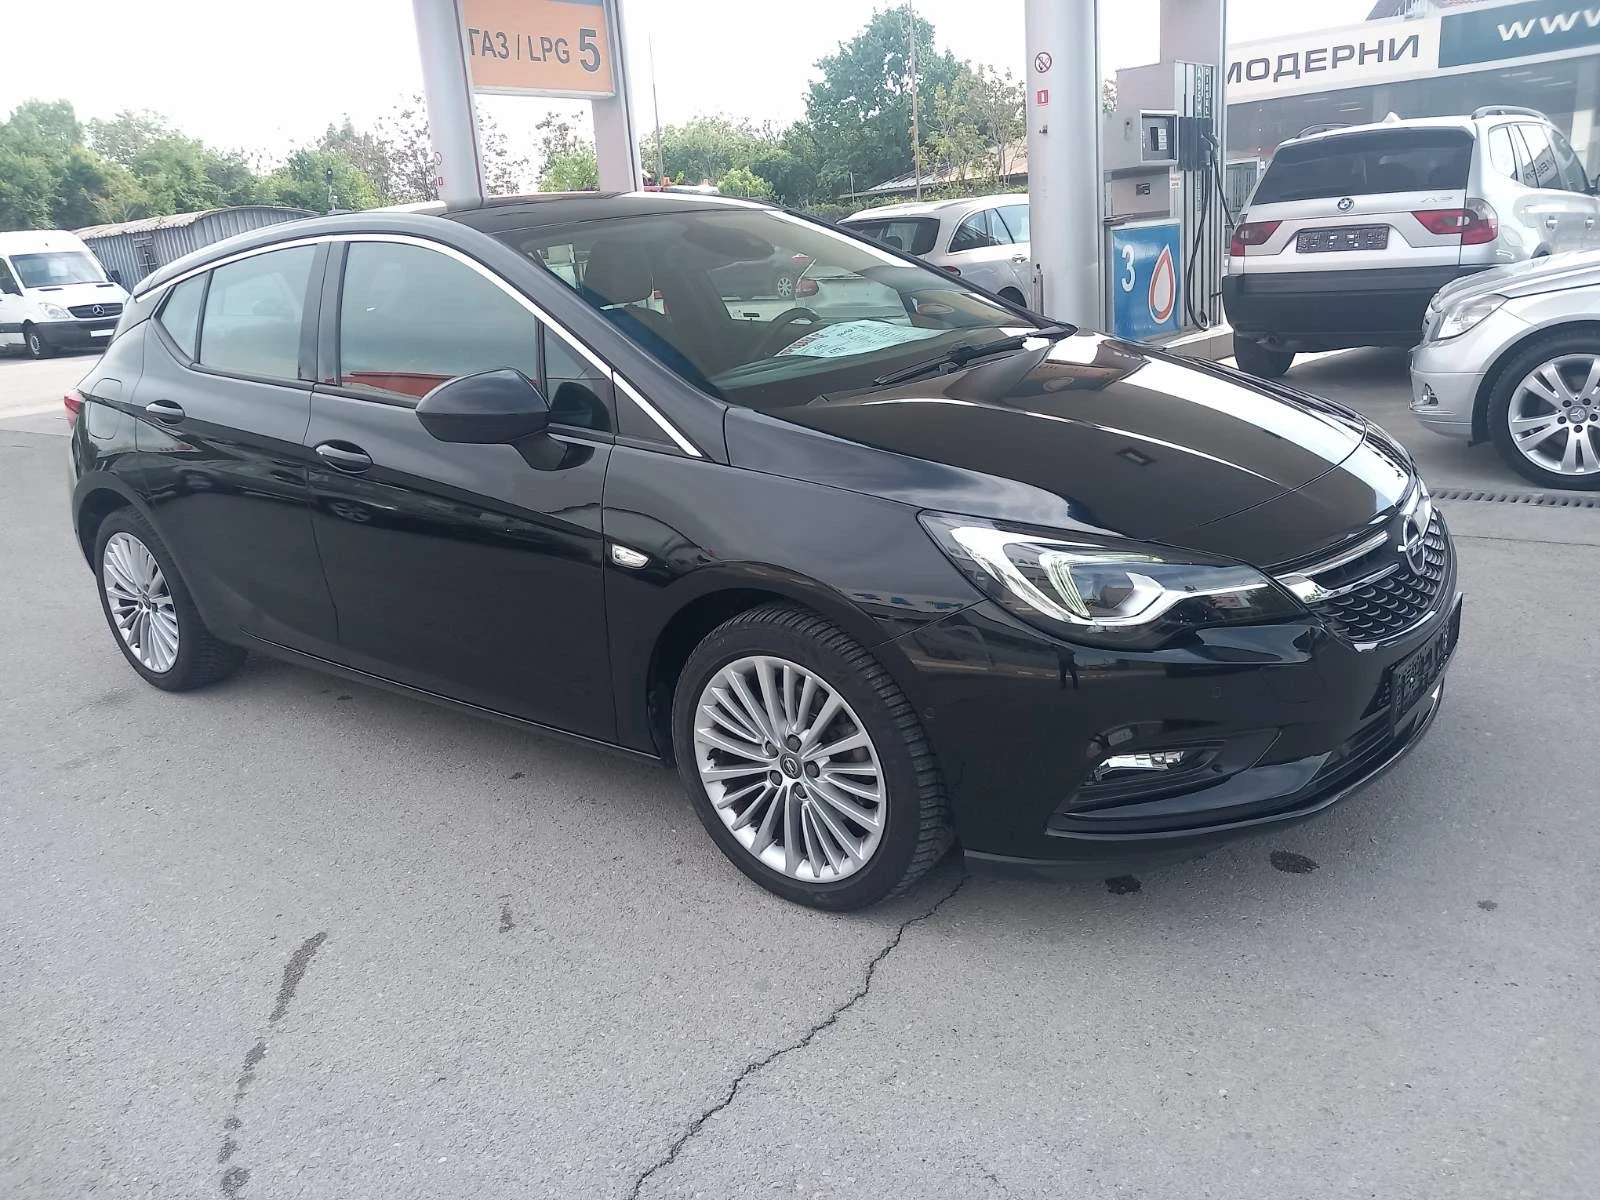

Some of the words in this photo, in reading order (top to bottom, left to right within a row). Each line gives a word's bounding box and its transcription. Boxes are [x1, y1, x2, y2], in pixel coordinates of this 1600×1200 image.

[468, 28, 510, 59] ГАЗ
[528, 35, 570, 64] LPG
[579, 28, 601, 72] 5
[1121, 244, 1136, 292] 3
